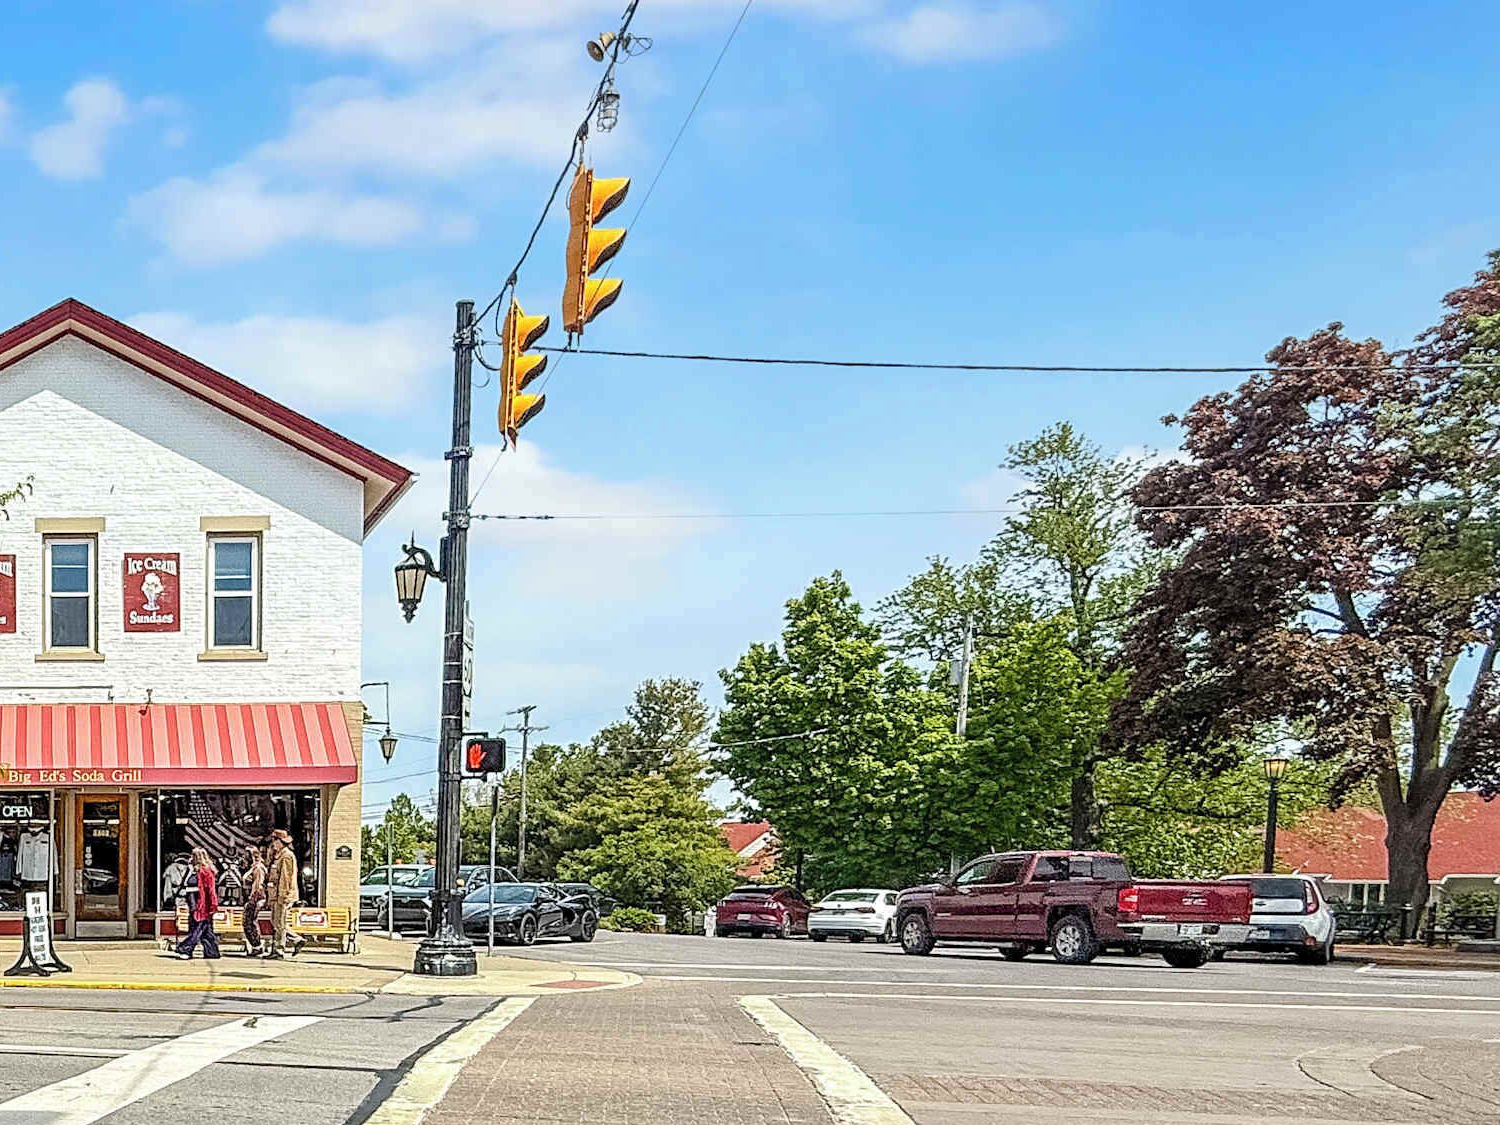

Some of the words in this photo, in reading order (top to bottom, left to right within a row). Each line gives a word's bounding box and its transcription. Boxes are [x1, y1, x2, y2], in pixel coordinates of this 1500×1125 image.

[127, 558, 143, 575] Ice
[144, 557, 177, 576] Cream
[129, 610, 174, 624] Sundaes
[8, 770, 31, 783] Big
[39, 770, 66, 782] Ed's
[73, 770, 105, 782] Soda
[112, 770, 142, 782] Grill
[2, 806, 33, 818] OPEN
